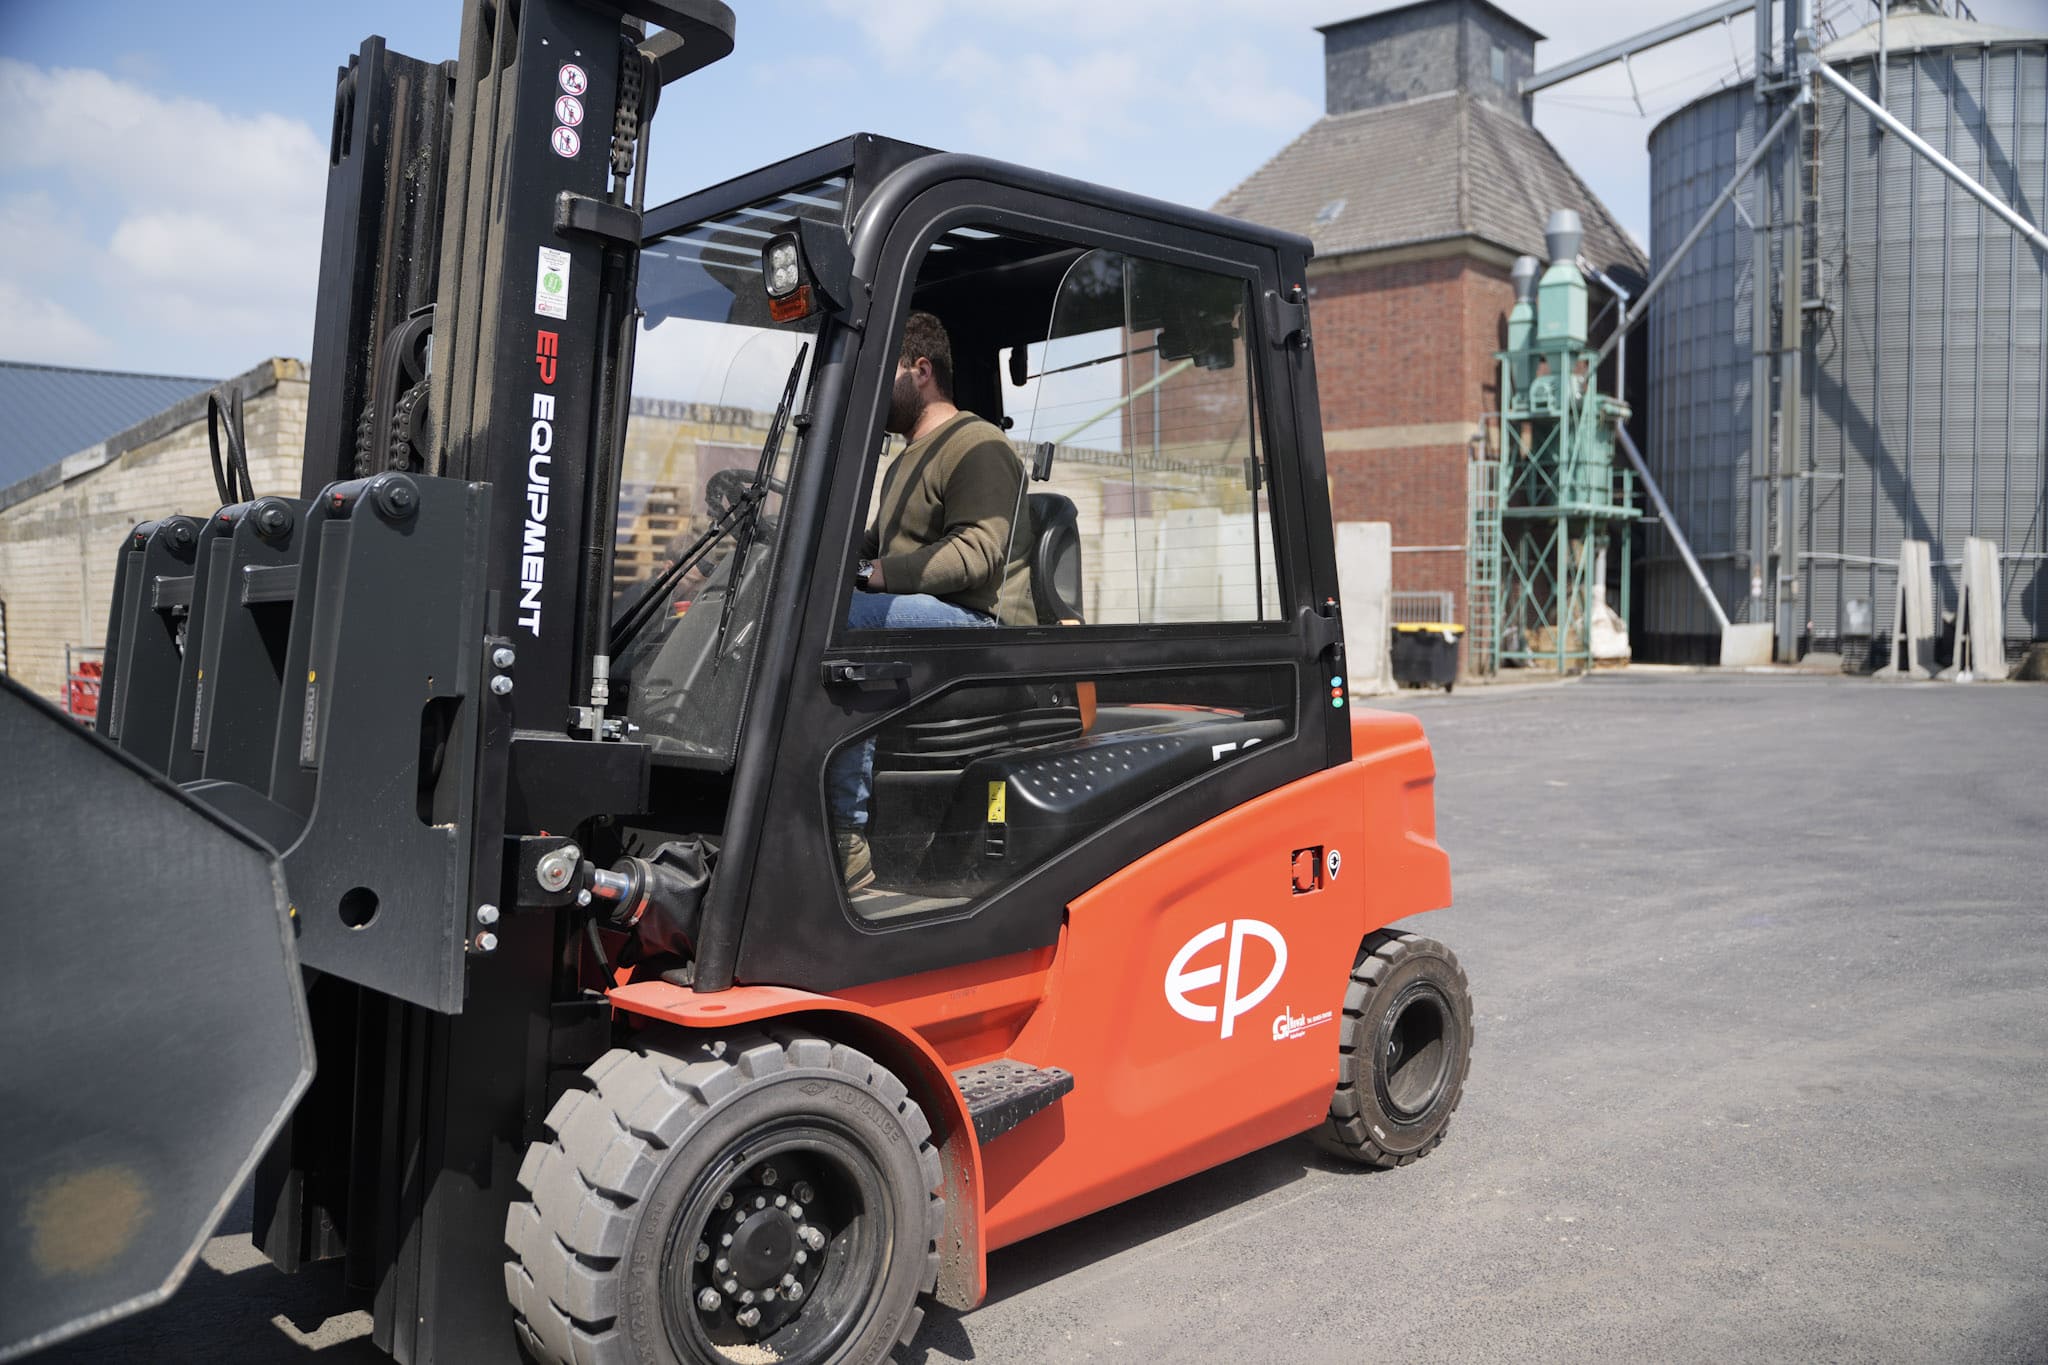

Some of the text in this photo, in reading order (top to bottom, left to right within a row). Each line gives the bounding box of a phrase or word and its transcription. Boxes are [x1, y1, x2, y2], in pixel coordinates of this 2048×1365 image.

[536, 330, 559, 385] EP
[518, 393, 555, 637] EQUIPMENT
[1164, 918, 1288, 1040] EP
[829, 1086, 900, 1145] ADVANCE
